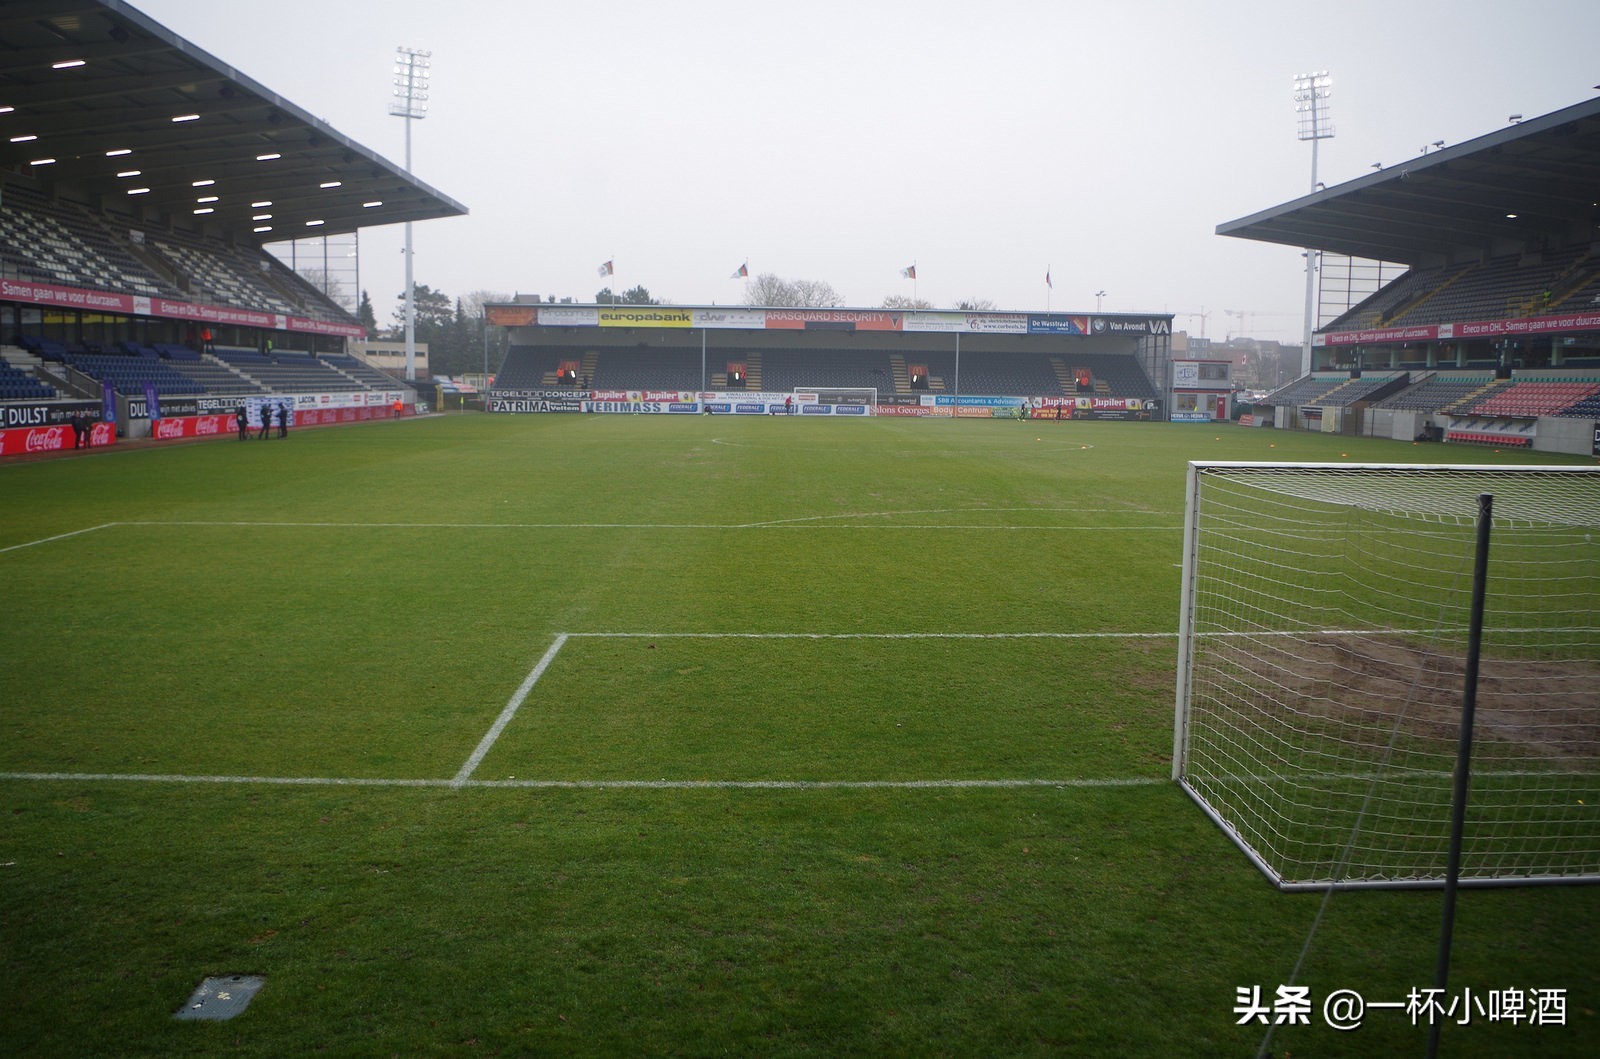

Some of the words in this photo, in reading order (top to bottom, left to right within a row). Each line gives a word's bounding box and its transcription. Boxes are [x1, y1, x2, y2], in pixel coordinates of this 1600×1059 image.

[1, 281, 32, 297] Samen
[33, 288, 54, 301] gaan
[55, 291, 67, 301] we
[68, 293, 85, 303] voor
[601, 313, 691, 322] europabank
[766, 311, 832, 321] ARASGUARD
[833, 311, 884, 322] SECURITY
[1110, 320, 1124, 330] Van
[1125, 321, 1146, 331] Avondt
[1149, 320, 1170, 334] VA
[1463, 324, 1480, 333] Eneco
[1481, 325, 1489, 333] en
[1505, 321, 1528, 331] Samen
[1529, 320, 1546, 332] gaan
[1546, 320, 1557, 329] we
[1558, 318, 1574, 327] voor
[1331, 334, 1345, 343] Eneco
[1360, 332, 1374, 341] Samen
[1375, 331, 1386, 342] gaan
[595, 391, 626, 400] Jupiler
[646, 391, 677, 401] Jupiler
[198, 399, 220, 410] TEGEL
[491, 401, 548, 412] PATRIMA
[585, 401, 662, 412] VERIMASS
[1043, 397, 1074, 407] Jupiler
[1094, 397, 1125, 407] Jupiler
[130, 402, 149, 417] DUL
[870, 405, 896, 415] Salons
[897, 406, 930, 416] Georges
[933, 405, 954, 414] Body
[957, 406, 989, 414] Centrum
[8, 407, 48, 425] DULST
